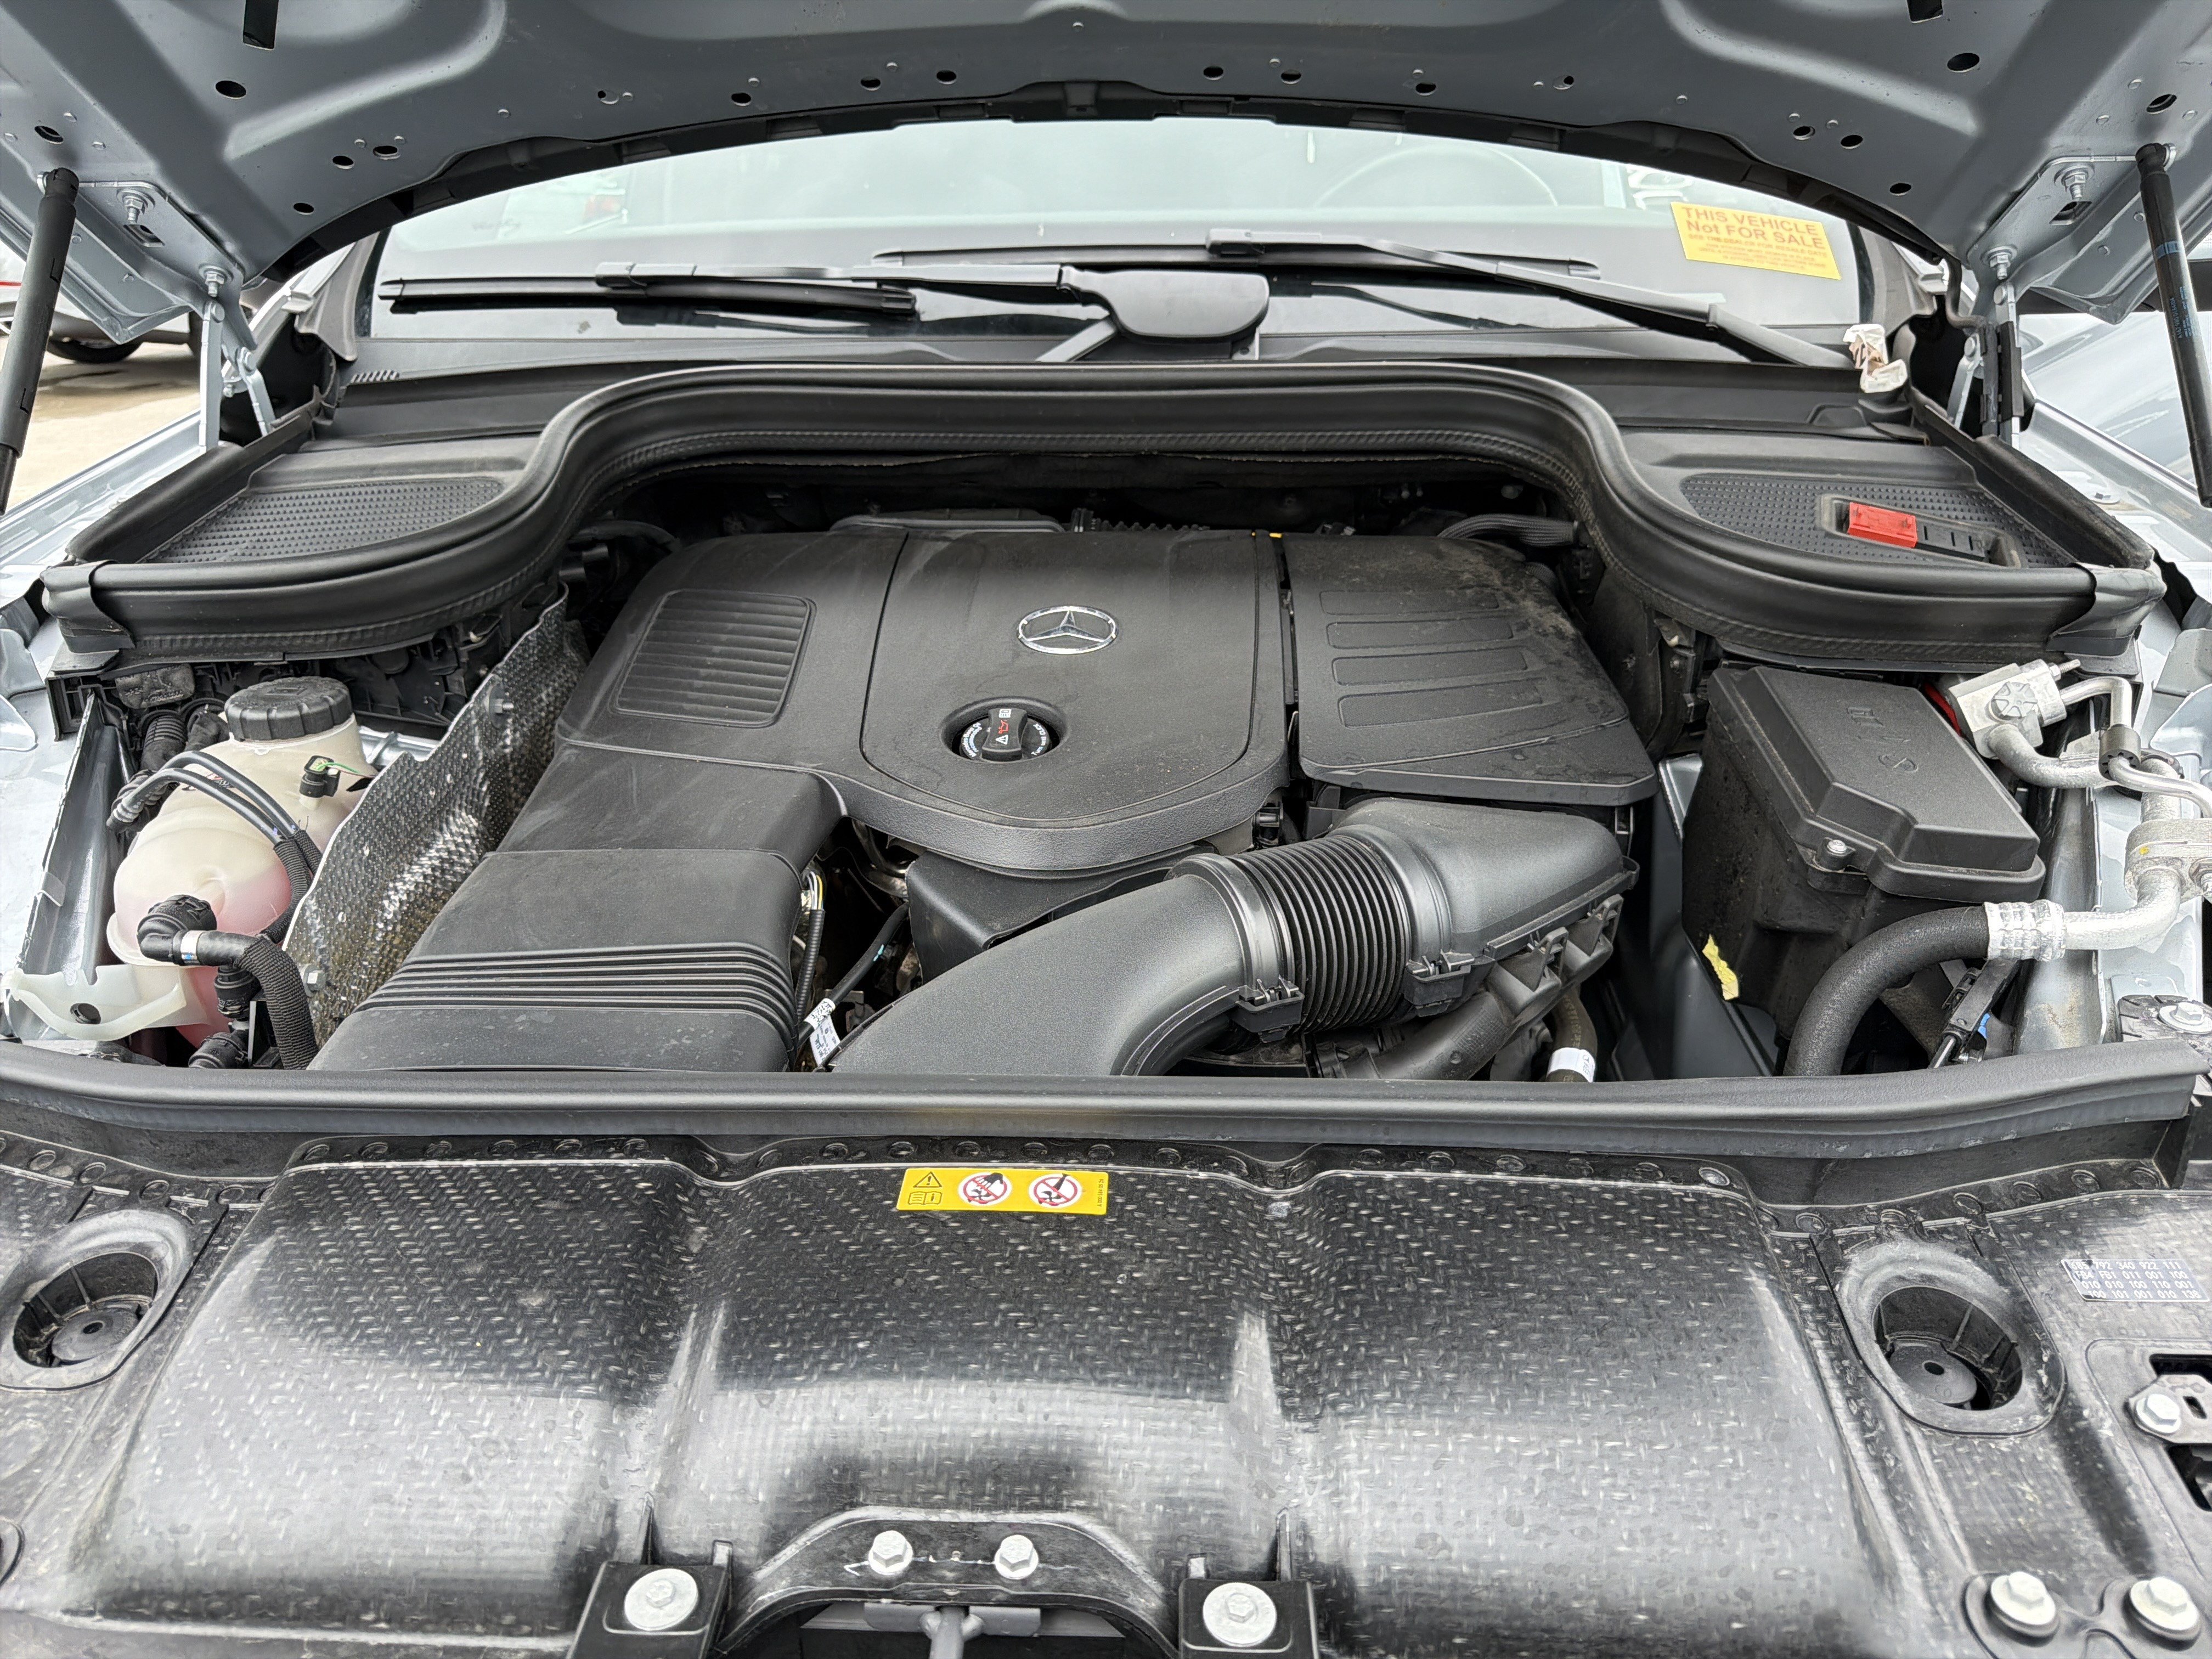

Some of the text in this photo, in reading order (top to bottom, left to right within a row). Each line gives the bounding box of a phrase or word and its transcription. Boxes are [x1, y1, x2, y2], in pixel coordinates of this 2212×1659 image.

[1681, 206, 1818, 235] THIS VEHICLE
[1685, 219, 1825, 249] Not FOR SALE
[1033, 723, 1046, 736] CLICK
[1031, 746, 1044, 756] Turn
[2071, 1261, 2182, 1269] 685 792 340 922 111
[2075, 1271, 2188, 1279] FB4 FB1 011 001 100
[2081, 1280, 2194, 1289] 010 010 100 110 001
[2087, 1290, 2202, 1299] 100 101 001 010 138
